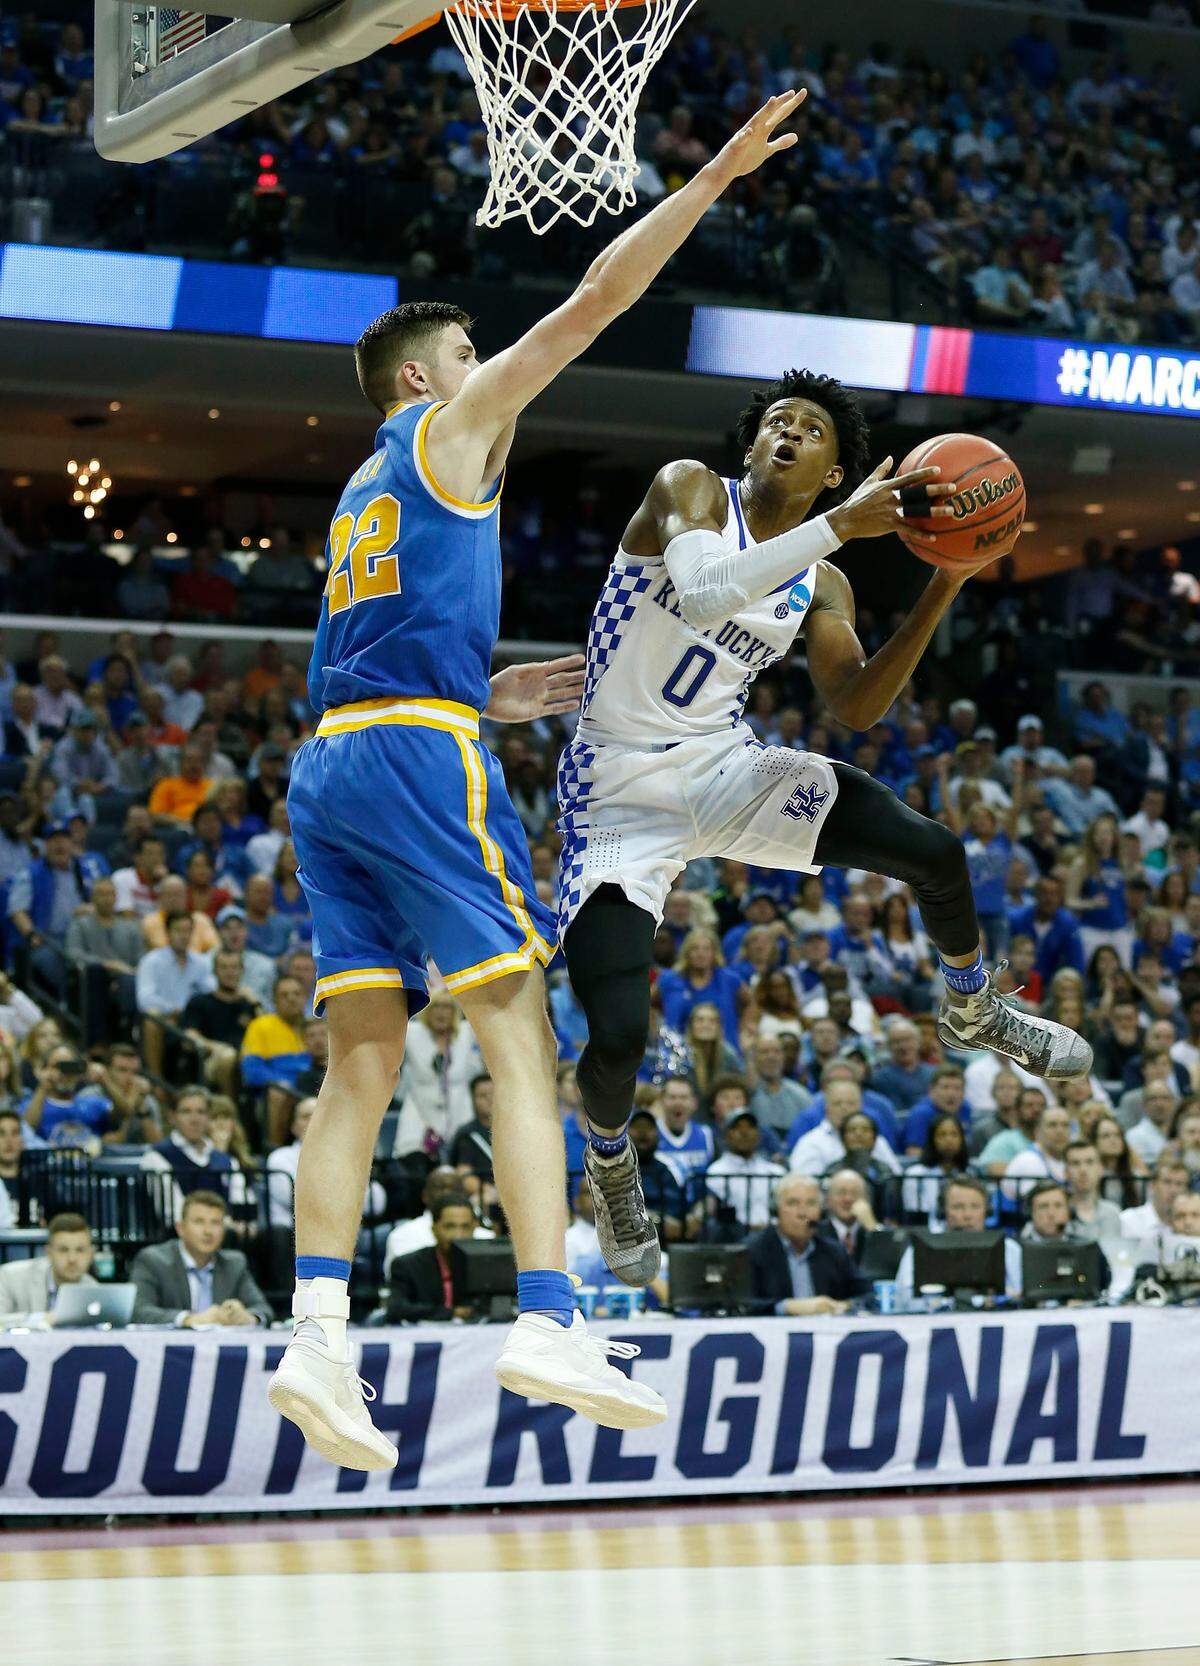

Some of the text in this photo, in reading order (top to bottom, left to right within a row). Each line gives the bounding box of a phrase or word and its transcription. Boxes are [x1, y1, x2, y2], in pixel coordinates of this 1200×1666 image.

[1057, 348, 1200, 410] #MARC
[949, 472, 1020, 520] Wilson
[328, 493, 402, 622] 22
[662, 644, 717, 708] 0
[0, 1342, 442, 1498] OUH
